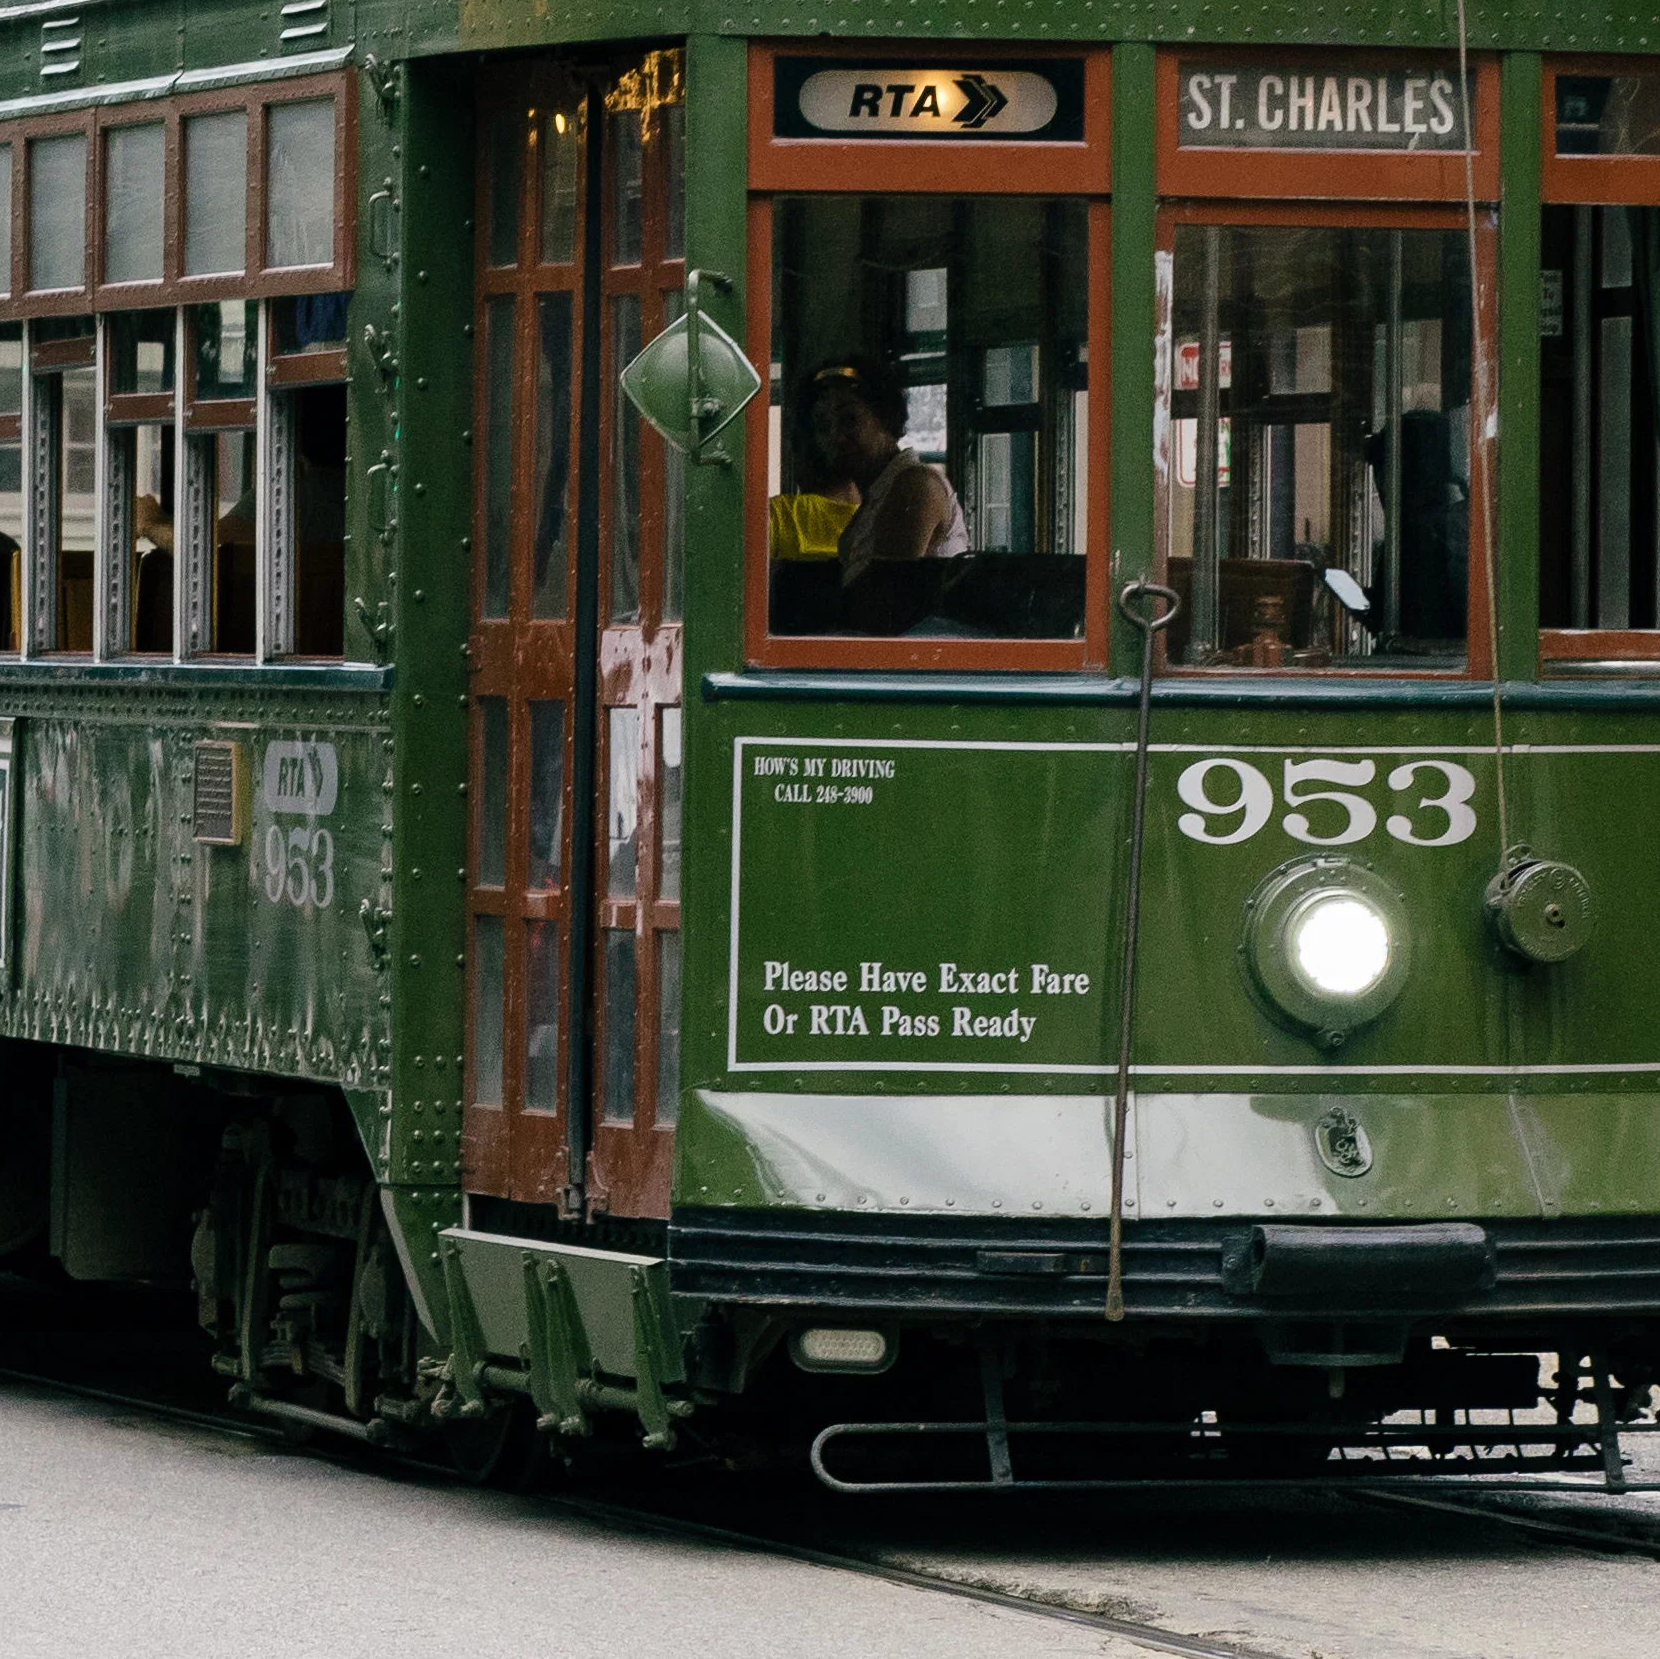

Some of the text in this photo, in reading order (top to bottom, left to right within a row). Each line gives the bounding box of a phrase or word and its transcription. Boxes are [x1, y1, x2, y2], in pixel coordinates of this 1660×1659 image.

[849, 83, 941, 117] RTA
[1187, 73, 1454, 135] ST. CHARLES
[278, 757, 305, 797] RTA
[754, 756, 896, 779] HOW'S MY DRIVING
[774, 783, 874, 804] CALL 248-3900
[1177, 758, 1477, 846] 953
[265, 824, 335, 909] 953
[763, 960, 1090, 994] Please Have Exact Fare
[763, 1004, 1037, 1043] Or RTA Pass Ready
